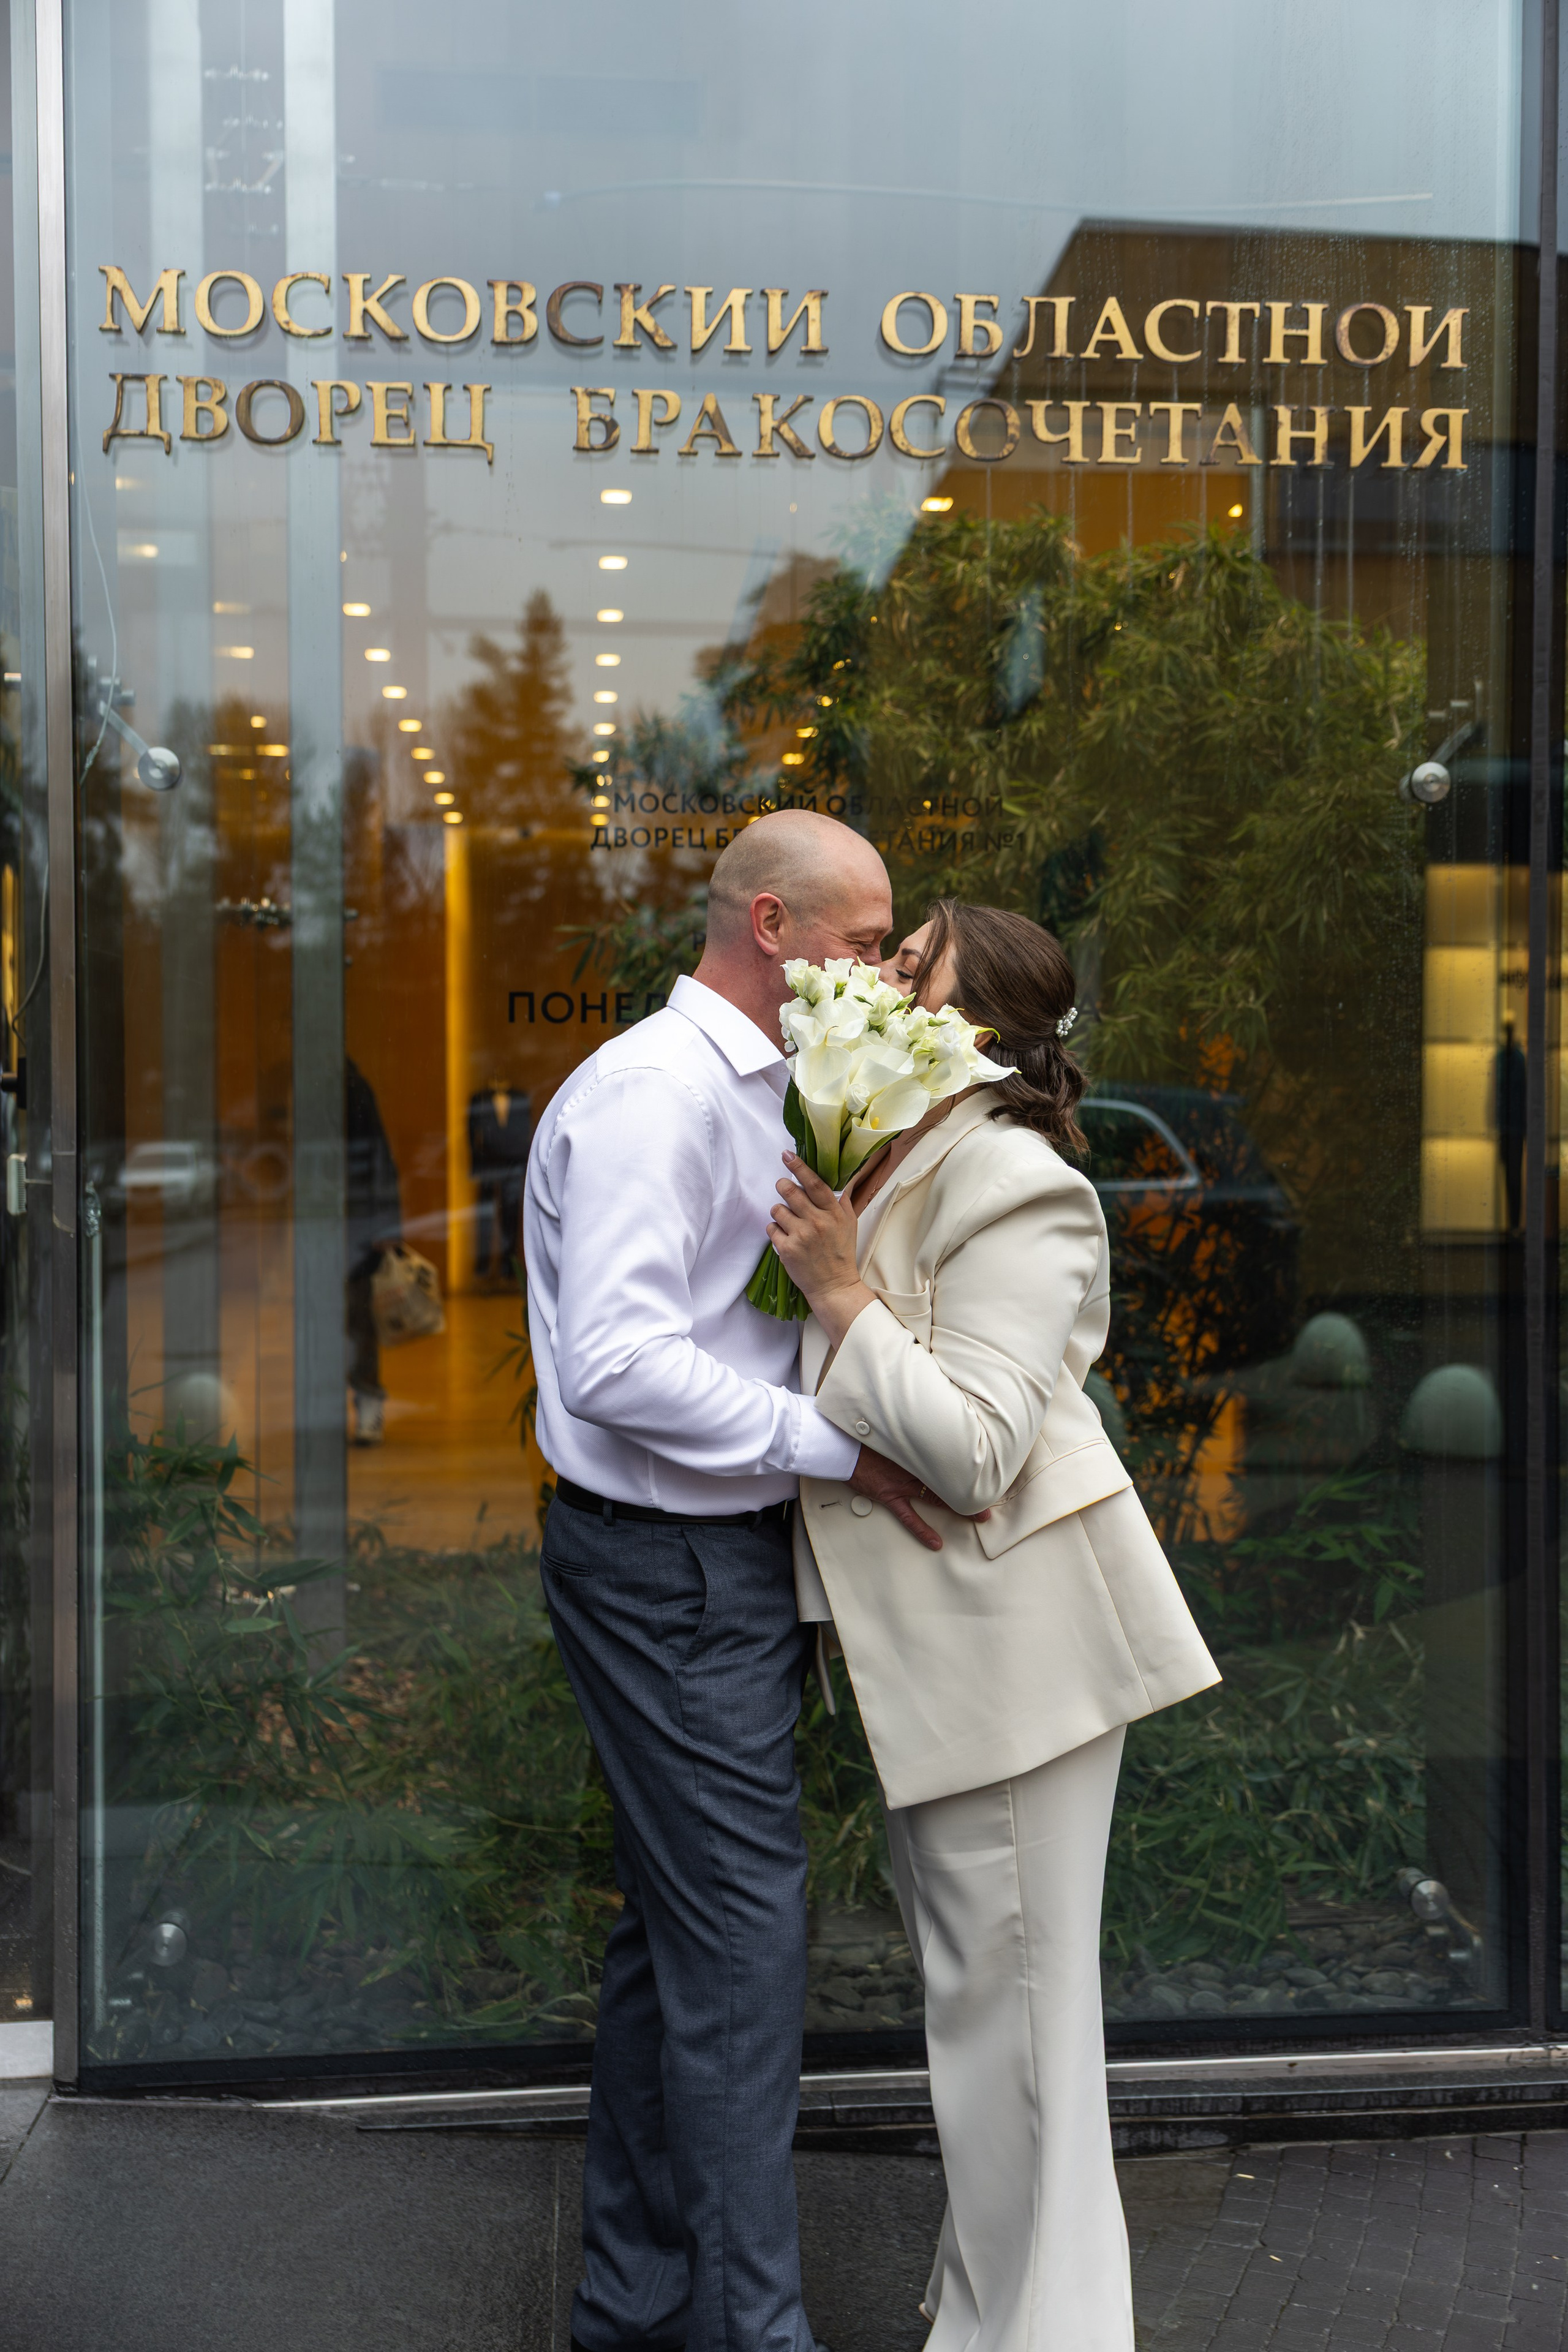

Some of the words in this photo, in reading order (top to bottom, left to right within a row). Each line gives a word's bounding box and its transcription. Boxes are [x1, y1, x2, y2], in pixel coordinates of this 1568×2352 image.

[102, 372, 494, 465] ДВОРЕЦ
[570, 386, 1469, 470] БРАКОСОЧЕТАНИЯ
[614, 789, 817, 814] МОСКОВСКИЙ
[590, 827, 707, 851] ДВОРЕЦ
